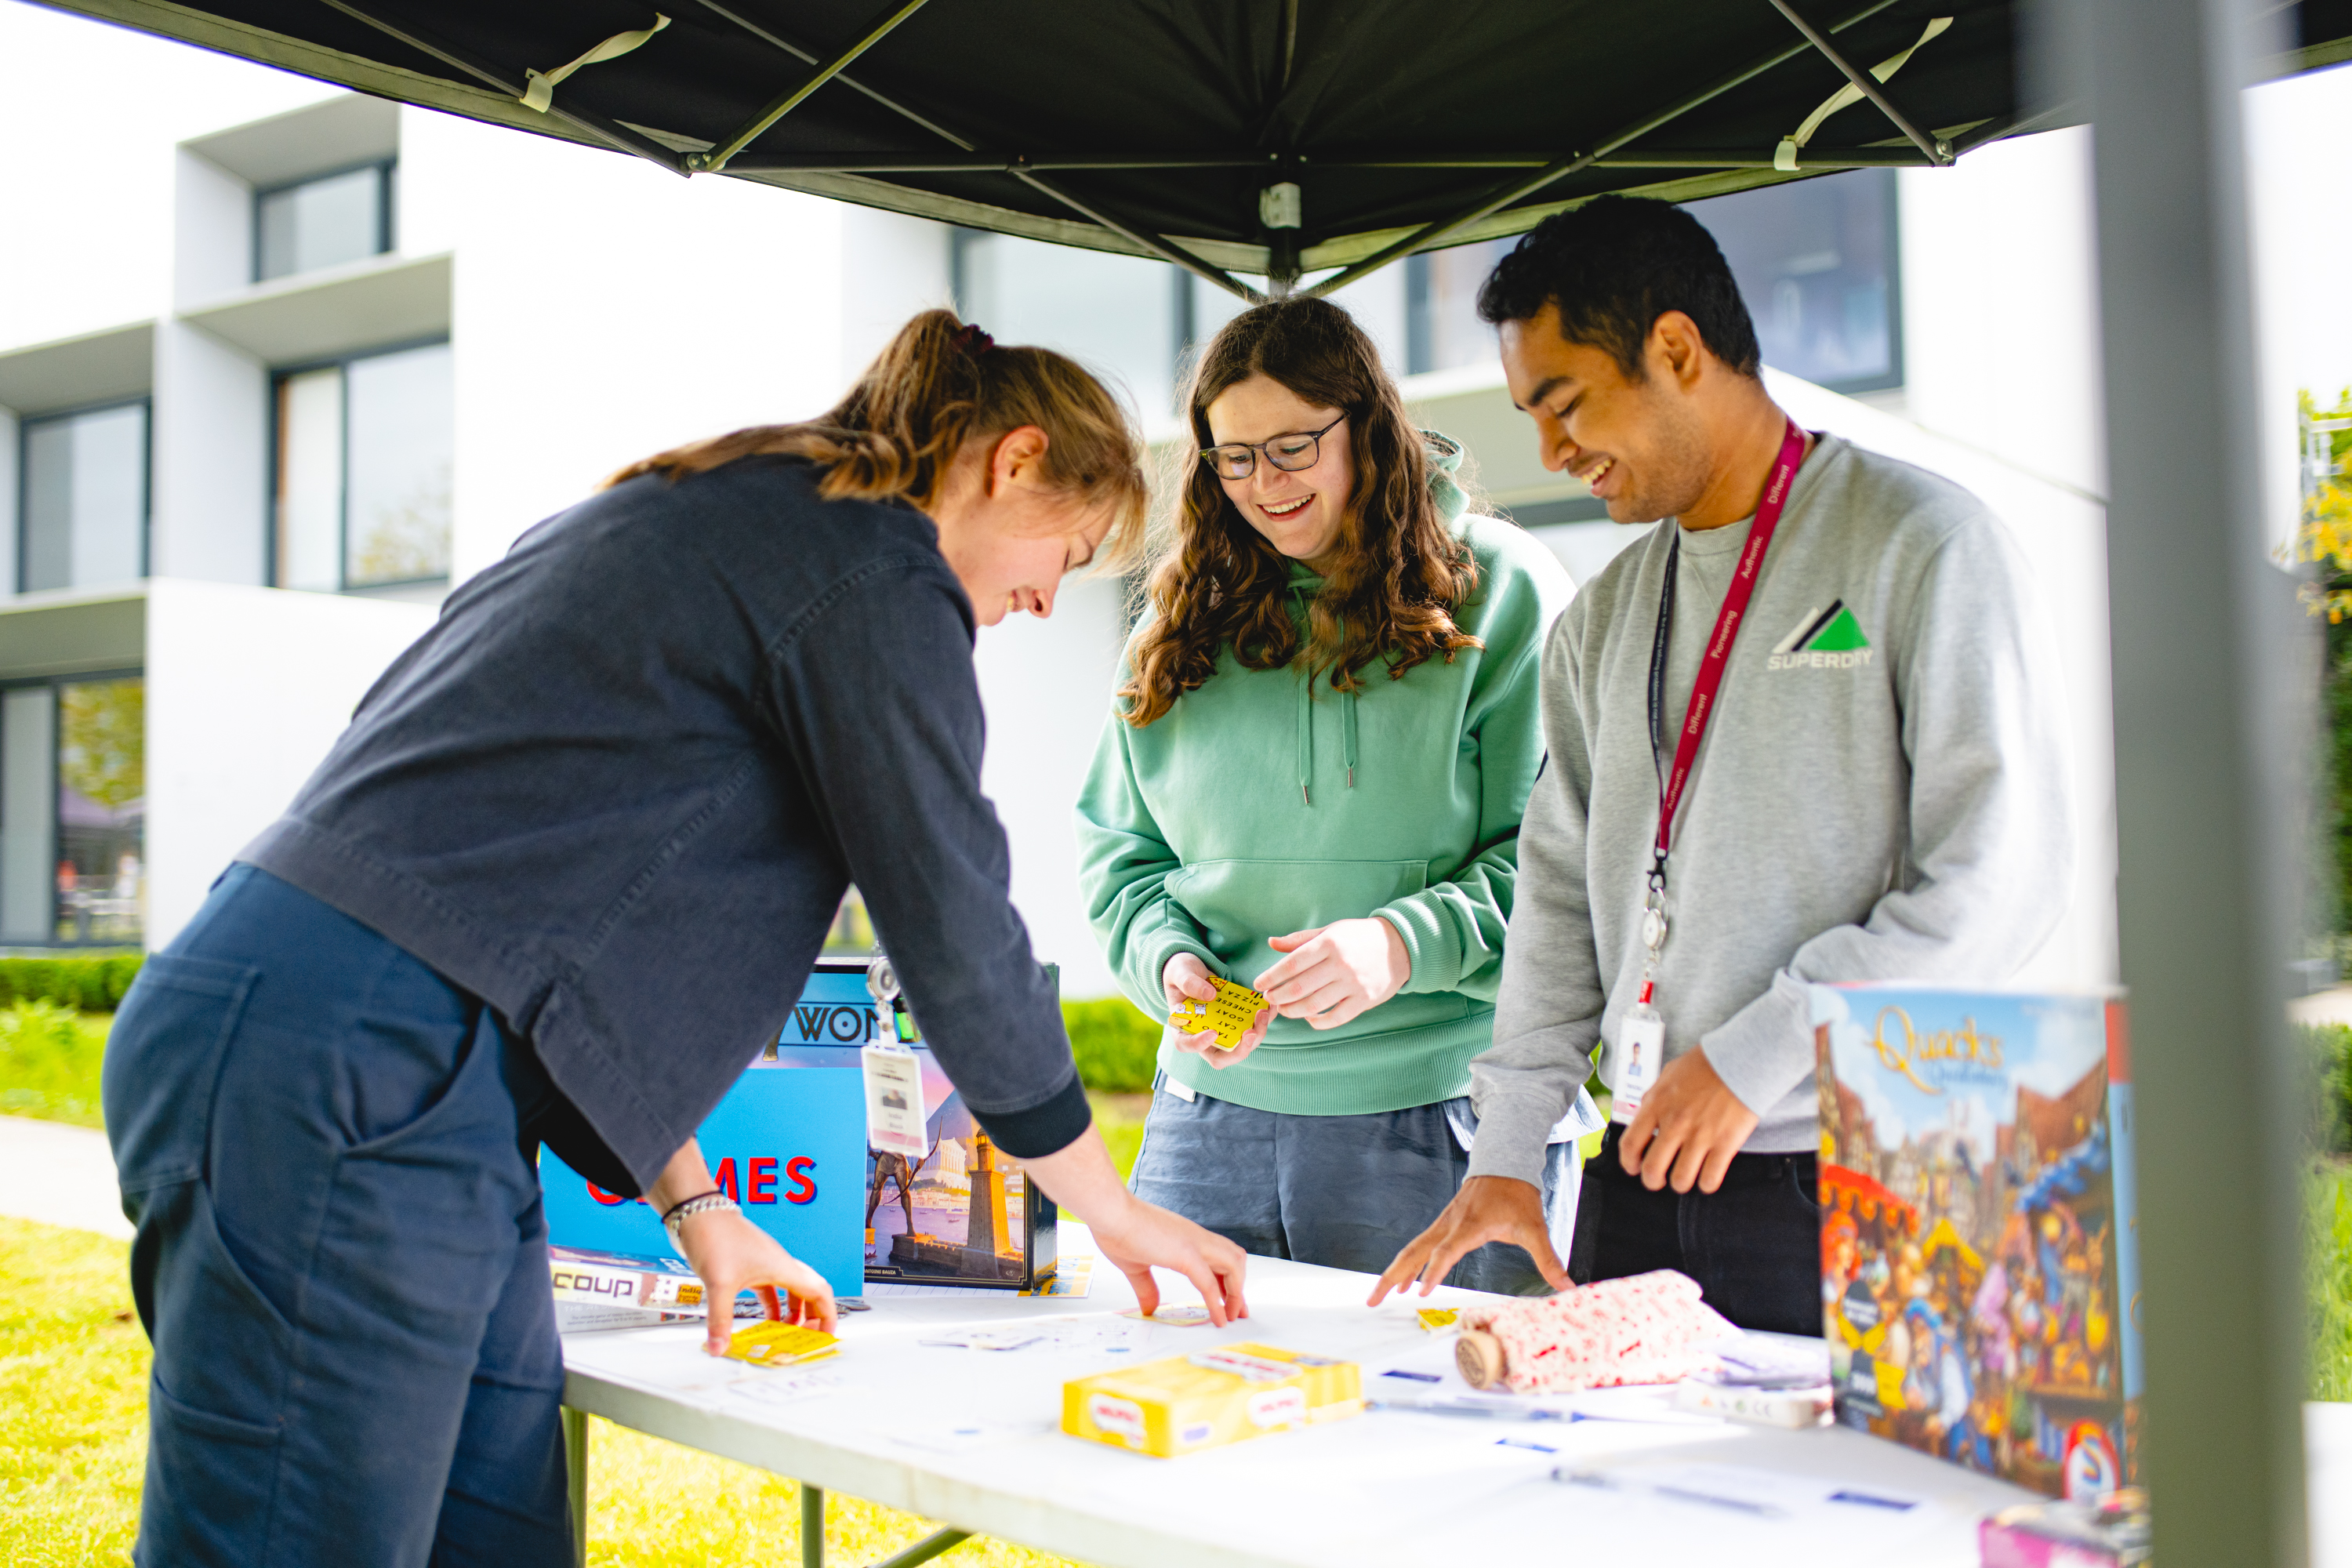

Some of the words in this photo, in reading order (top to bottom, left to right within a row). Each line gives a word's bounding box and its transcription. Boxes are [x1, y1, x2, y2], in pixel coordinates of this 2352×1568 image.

[1768, 465, 1791, 504] Different
[1741, 535, 1763, 579] Authentic
[1711, 610, 1737, 659] Pioneering
[1687, 694, 1708, 735] Different
[1667, 768, 1685, 810] Authentic
[1217, 996, 1252, 1014] CHEESE
[1227, 990, 1260, 1007] PIZZA
[1215, 1008, 1244, 1022] GOAT
[1217, 1020, 1237, 1030] CAT
[1202, 1025, 1229, 1040] TAO
